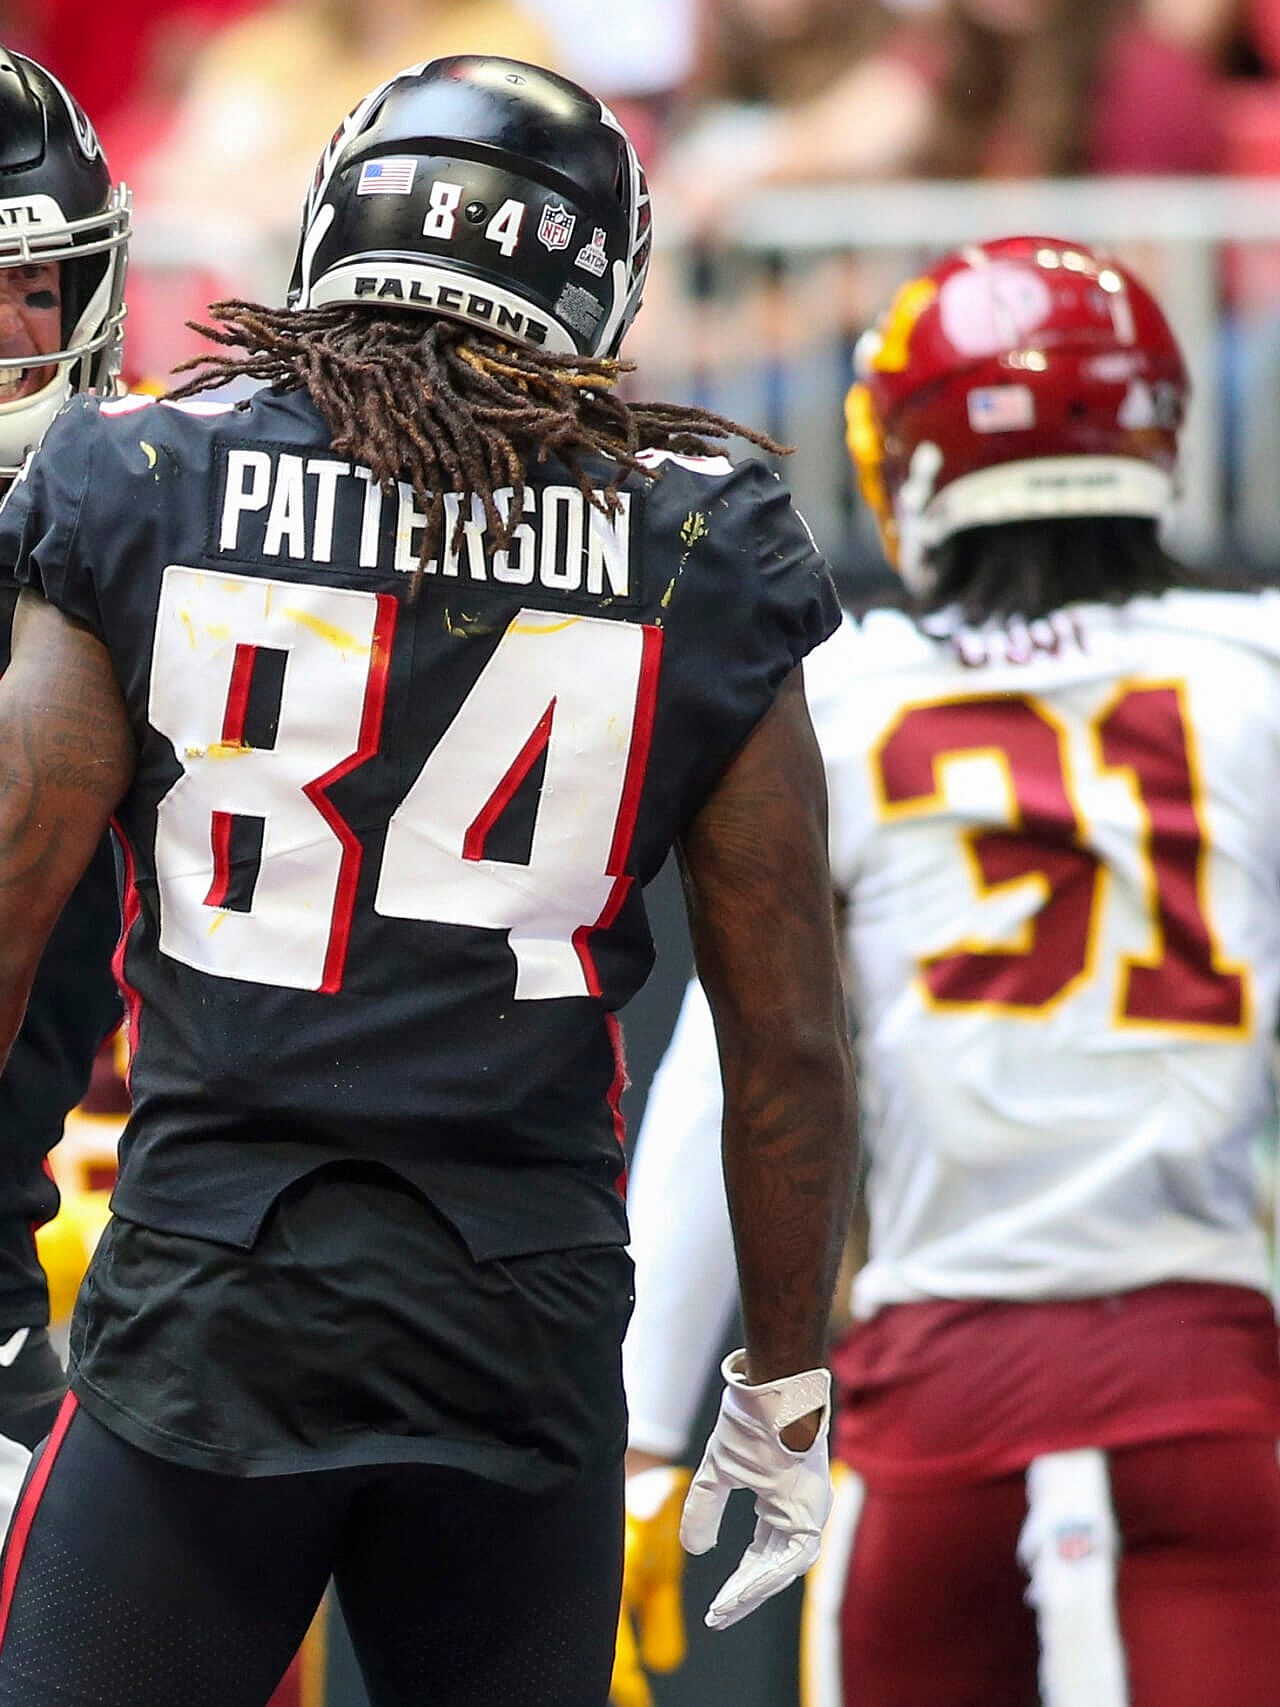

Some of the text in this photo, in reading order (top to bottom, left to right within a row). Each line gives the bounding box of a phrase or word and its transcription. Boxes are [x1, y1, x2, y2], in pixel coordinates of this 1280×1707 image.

[354, 276, 549, 345] FALCONS
[219, 449, 632, 597] PATTERSON
[146, 565, 664, 1001] 84
[867, 676, 1256, 1044] 31
